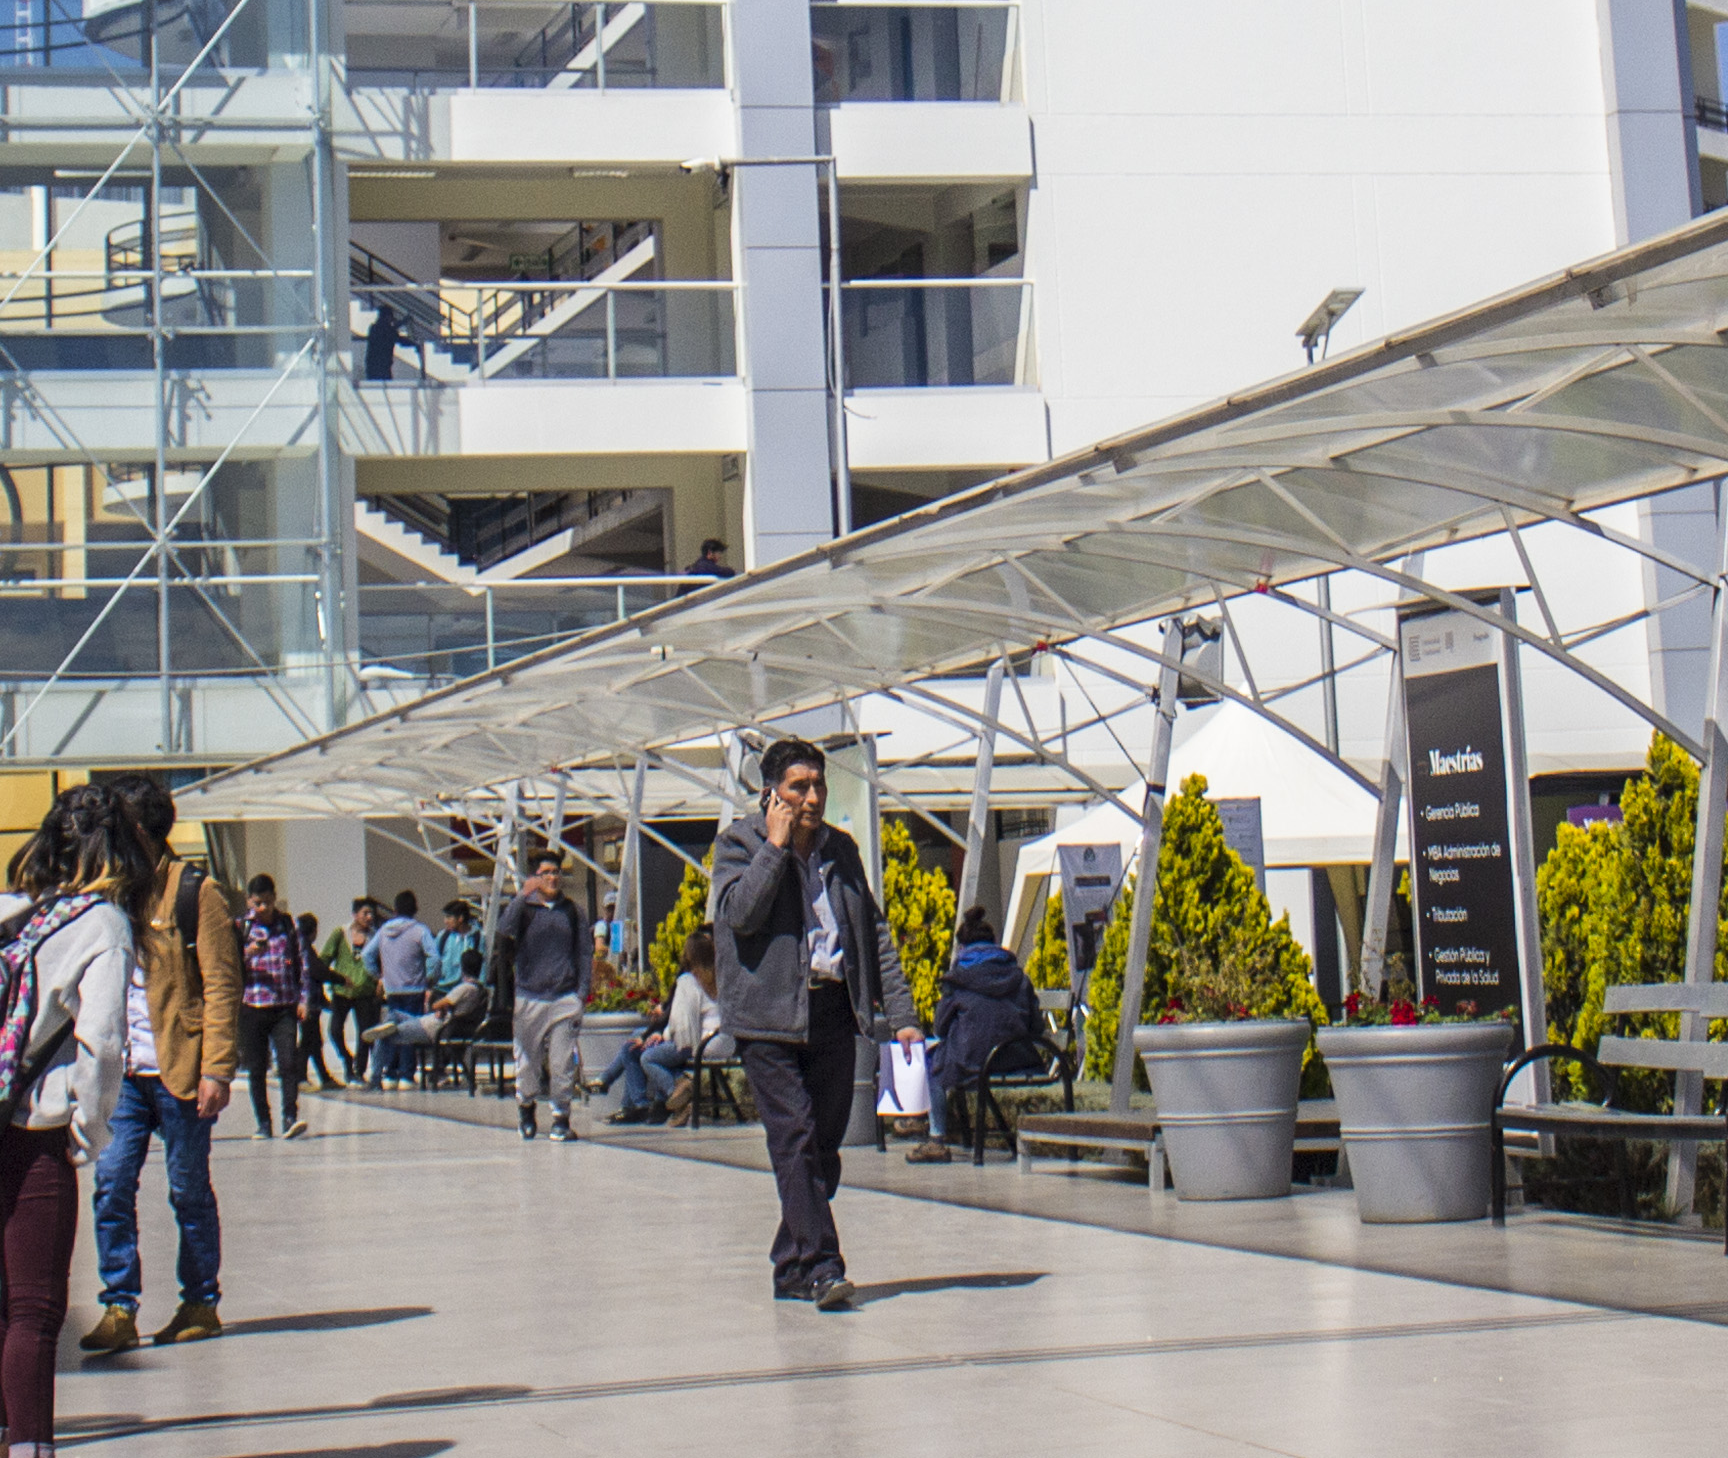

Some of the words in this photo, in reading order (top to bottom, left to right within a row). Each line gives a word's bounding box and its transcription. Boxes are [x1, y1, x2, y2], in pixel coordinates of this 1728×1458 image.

[1428, 745, 1484, 777] Maestrías
[1425, 804, 1455, 821] Gerencia
[1455, 802, 1480, 818] Pública
[1427, 845, 1443, 860] MBA
[1443, 842, 1490, 860] Administración
[1491, 842, 1502, 857] de
[1428, 867, 1460, 886] Negocios
[1432, 906, 1468, 923] Tributación
[1434, 947, 1459, 963] Gestión
[1460, 946, 1485, 963] Pública
[1461, 969, 1471, 985] de
[1479, 968, 1500, 985] Salud
